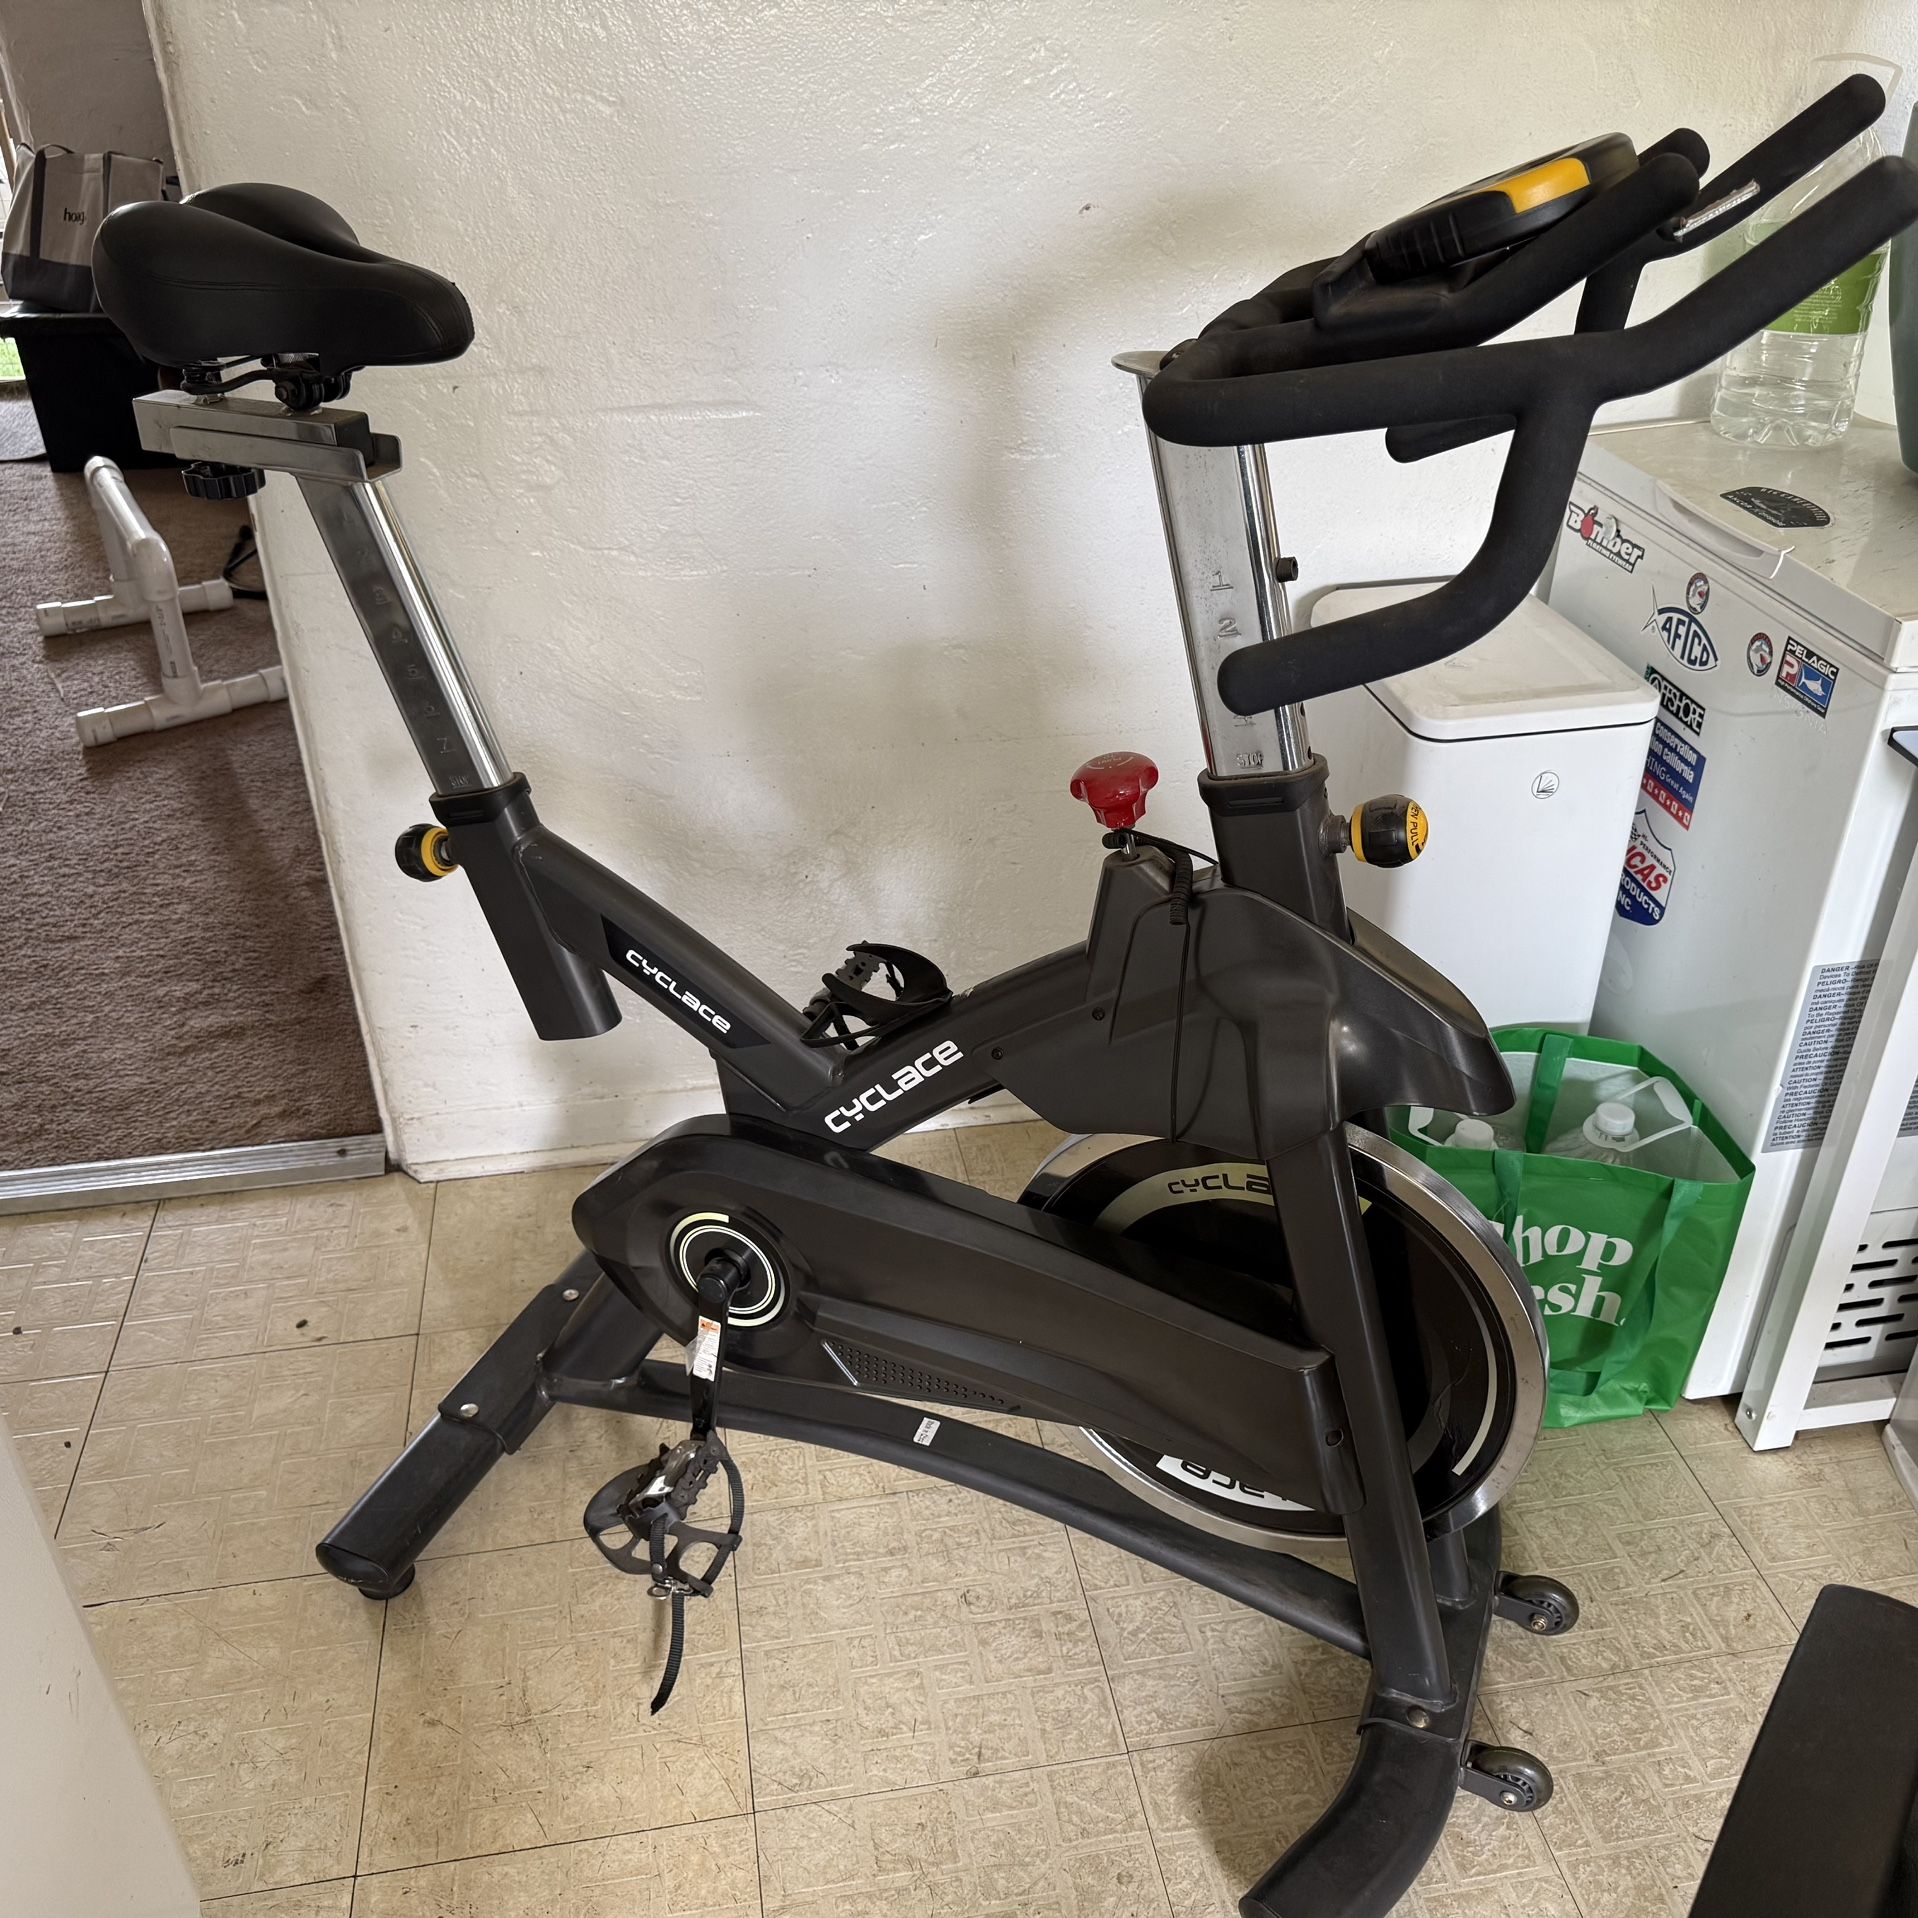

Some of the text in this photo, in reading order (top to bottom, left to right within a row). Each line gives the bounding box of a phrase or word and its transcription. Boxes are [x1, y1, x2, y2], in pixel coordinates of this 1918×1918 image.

[1661, 616, 1710, 666] AFTCO
[1786, 640, 1837, 680] PELAGIC
[1410, 821, 1420, 847] PULL
